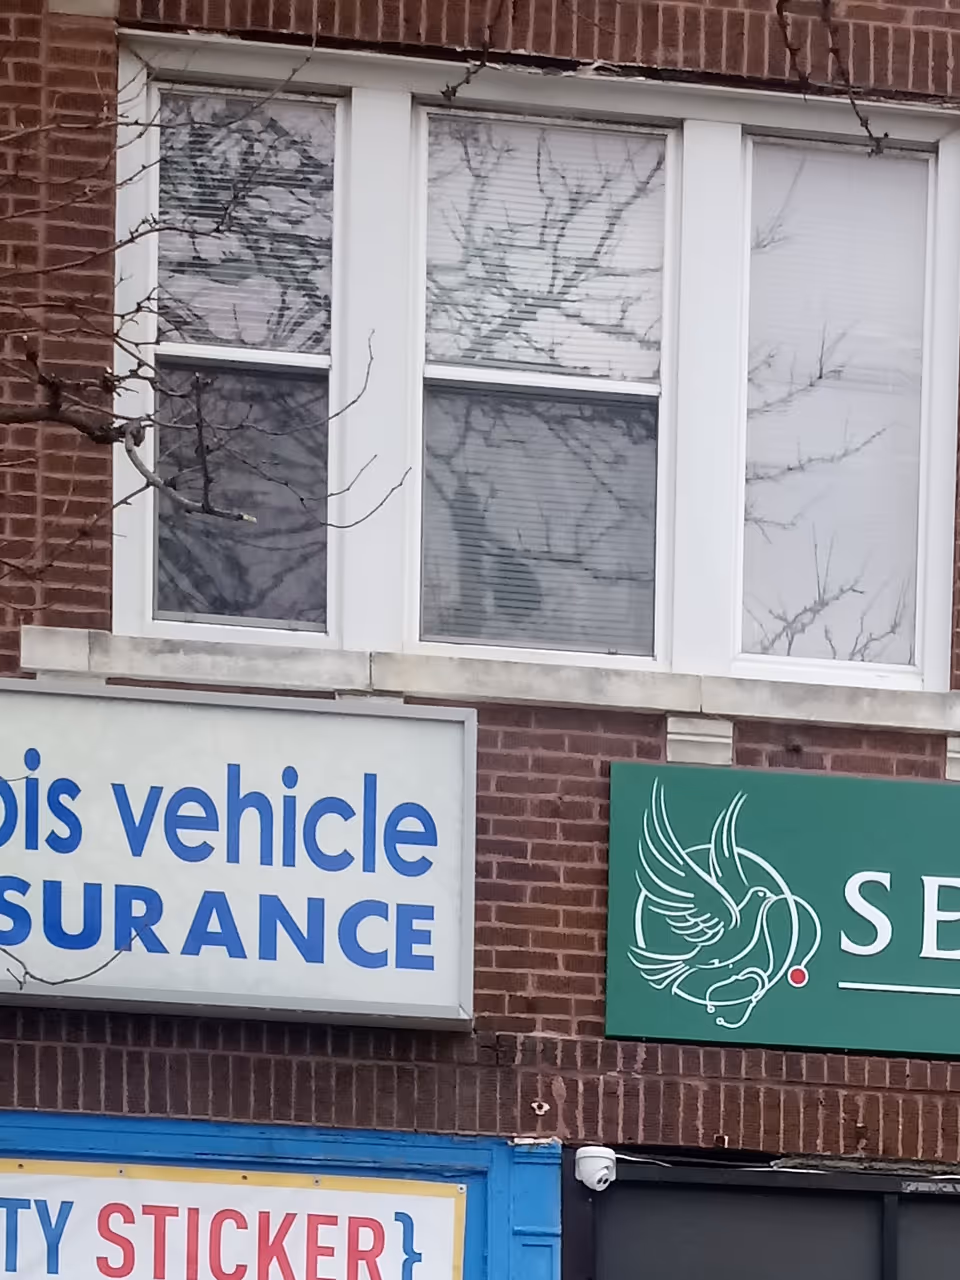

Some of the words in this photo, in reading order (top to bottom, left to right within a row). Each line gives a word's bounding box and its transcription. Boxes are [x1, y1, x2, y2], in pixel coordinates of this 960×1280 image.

[113, 764, 438, 877] vehicle
[0, 876, 435, 971] SURANCE
[0, 1198, 73, 1275] TY
